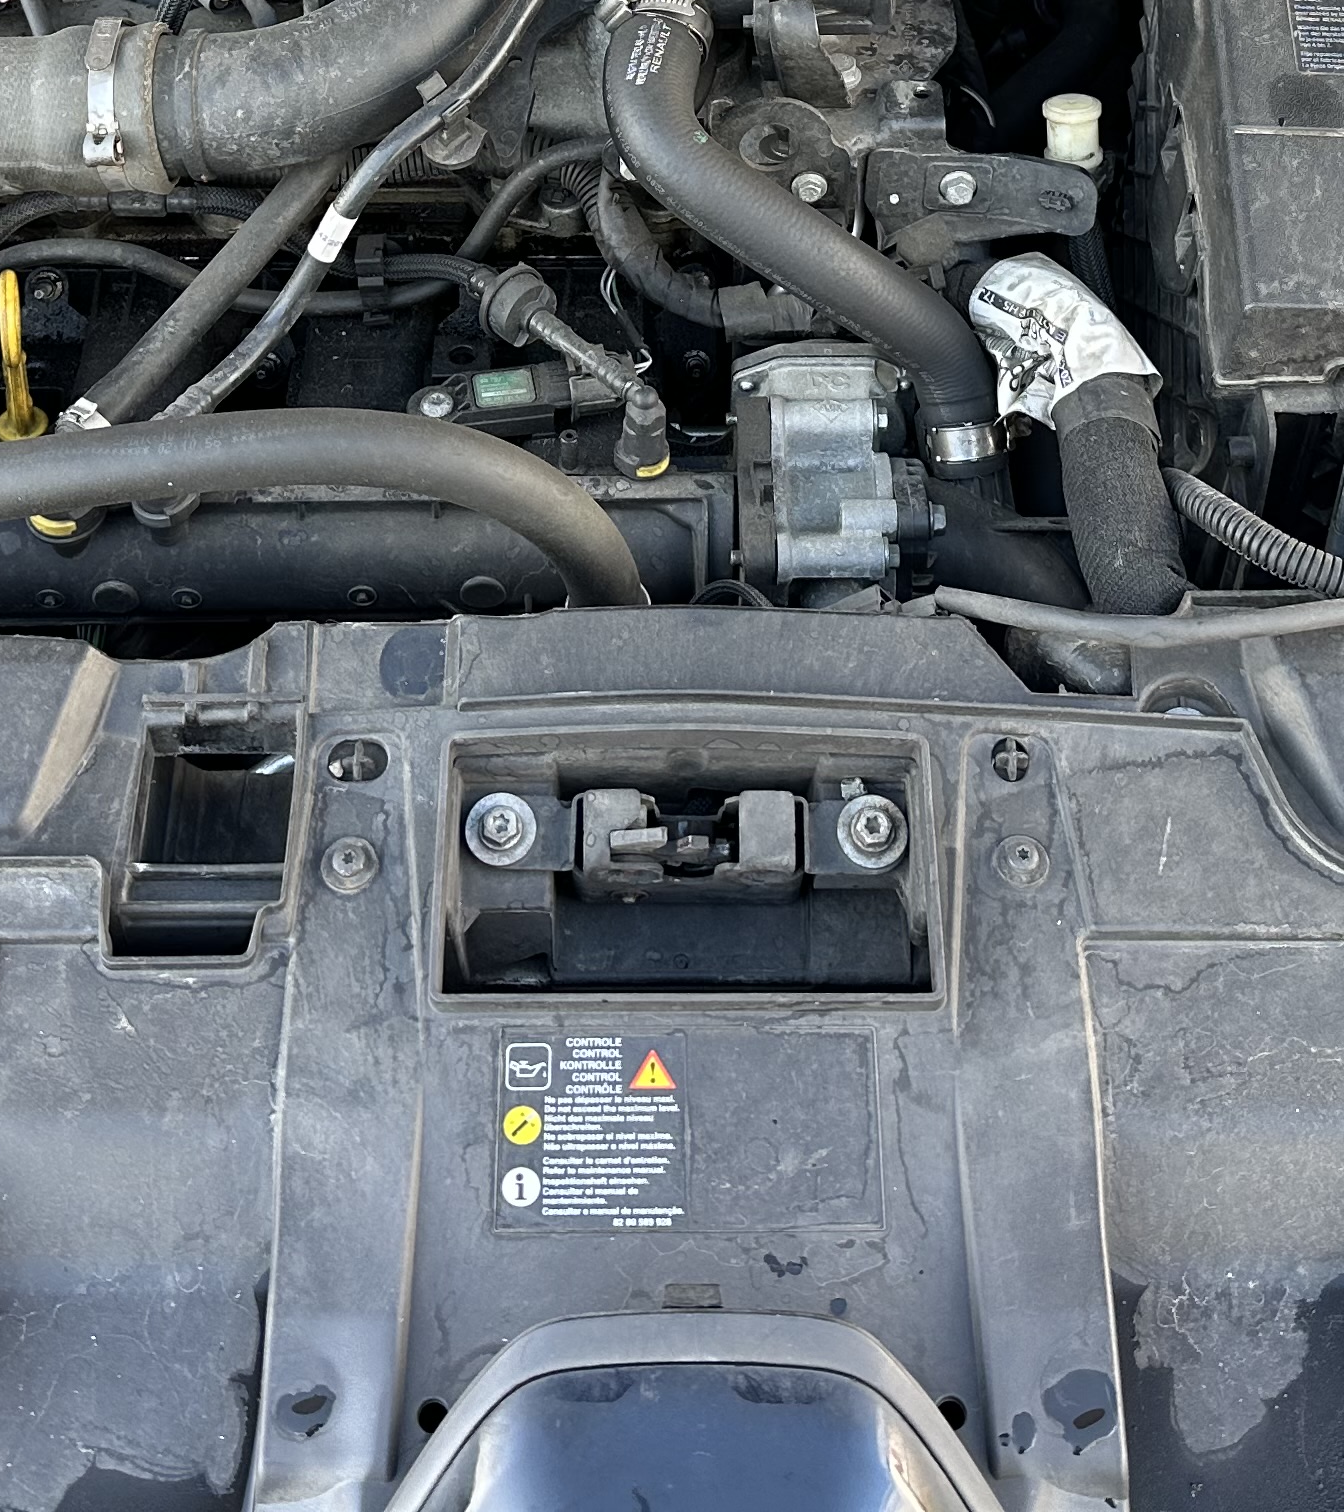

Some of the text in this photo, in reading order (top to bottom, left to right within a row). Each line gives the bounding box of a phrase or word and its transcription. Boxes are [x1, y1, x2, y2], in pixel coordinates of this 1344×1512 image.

[650, 22, 672, 73] RENAULT
[566, 1037, 622, 1047] CONTROLE
[572, 1048, 623, 1058] CONTROL
[559, 1060, 622, 1070] KONTROLLE
[572, 1072, 622, 1082] CONTROL
[566, 1082, 623, 1094] CONTRÔLE
